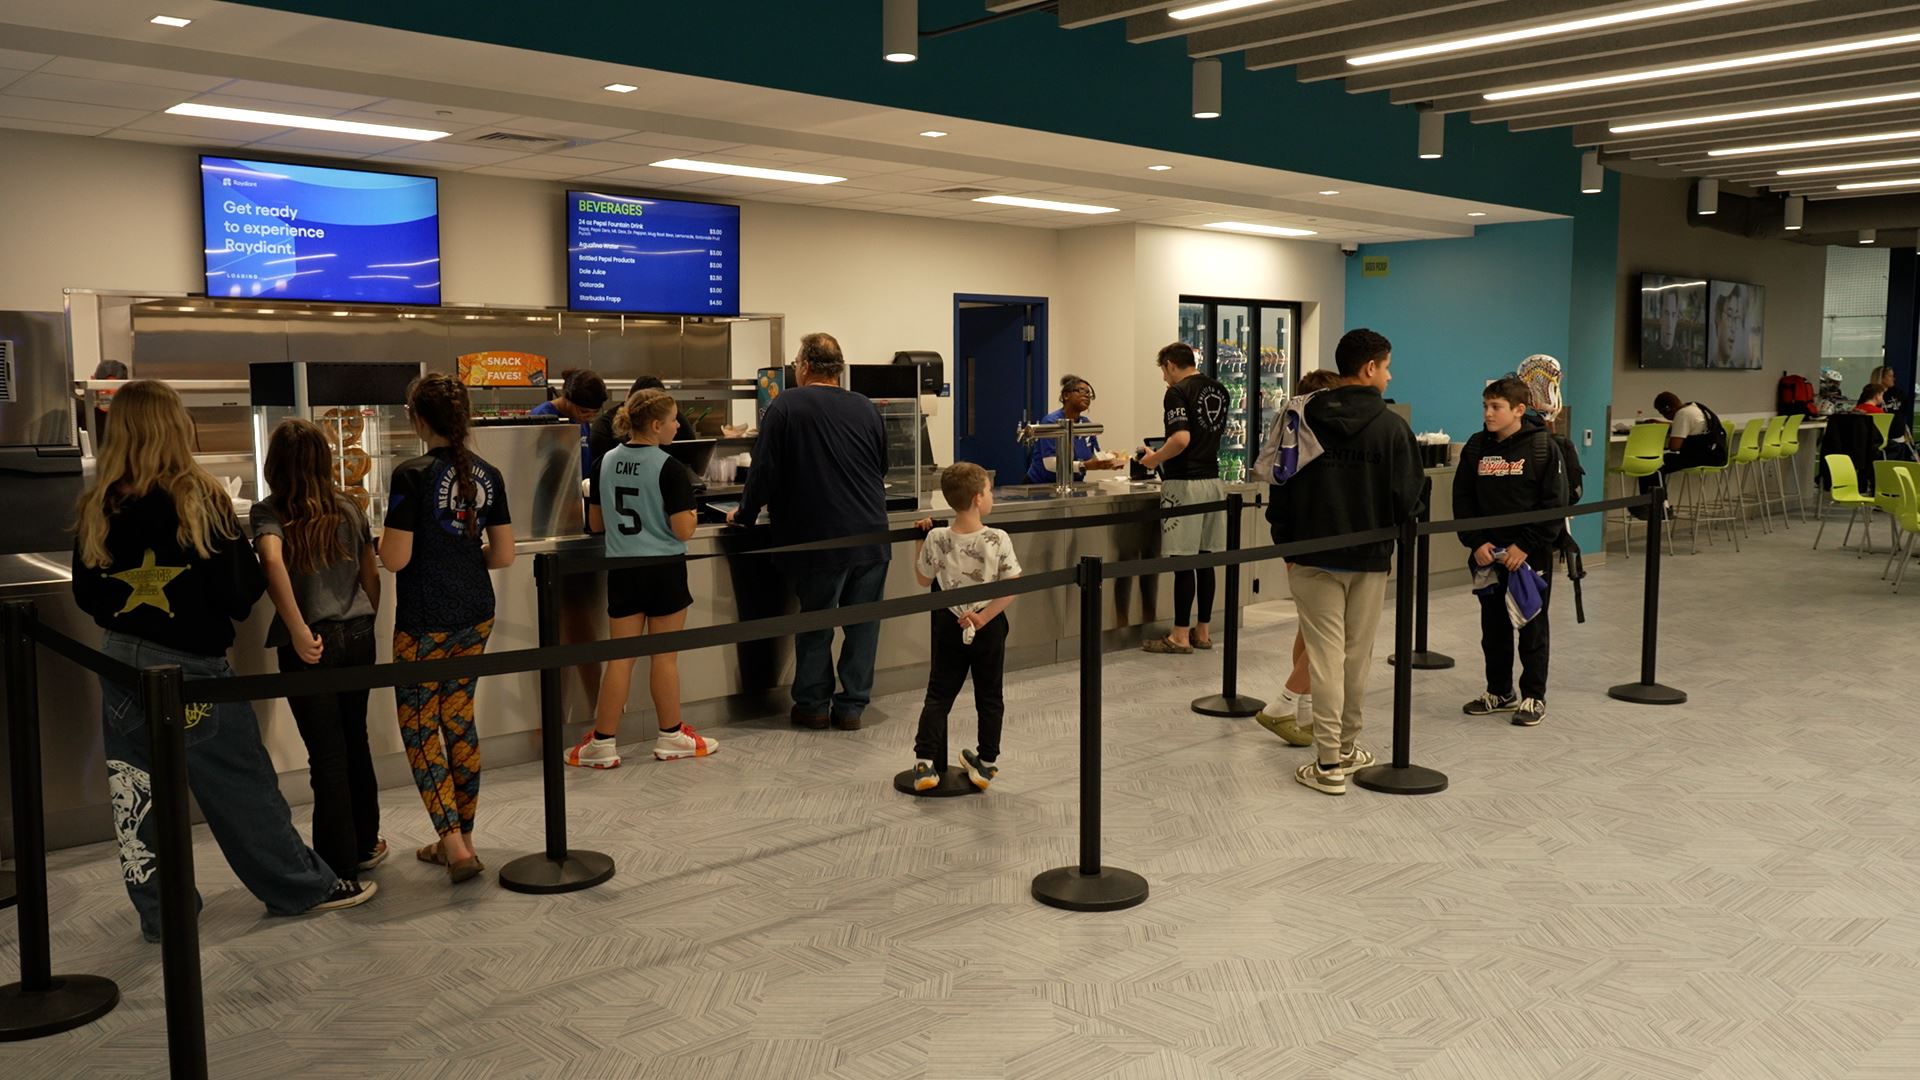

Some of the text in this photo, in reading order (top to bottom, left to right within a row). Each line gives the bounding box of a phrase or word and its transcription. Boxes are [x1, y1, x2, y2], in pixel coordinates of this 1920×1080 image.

[223, 200, 298, 220] Get ready
[579, 200, 643, 216] BEVERAGES
[224, 220, 325, 239] to experience
[225, 238, 296, 256] Raydiant.
[613, 256, 636, 264] Products
[579, 281, 605, 289] Gatorade
[579, 294, 621, 303] Starbucks Frapp
[487, 357, 521, 366] SNACK
[487, 371, 521, 380] FAVES!
[616, 461, 641, 476] CAVE
[615, 486, 642, 535] 5
